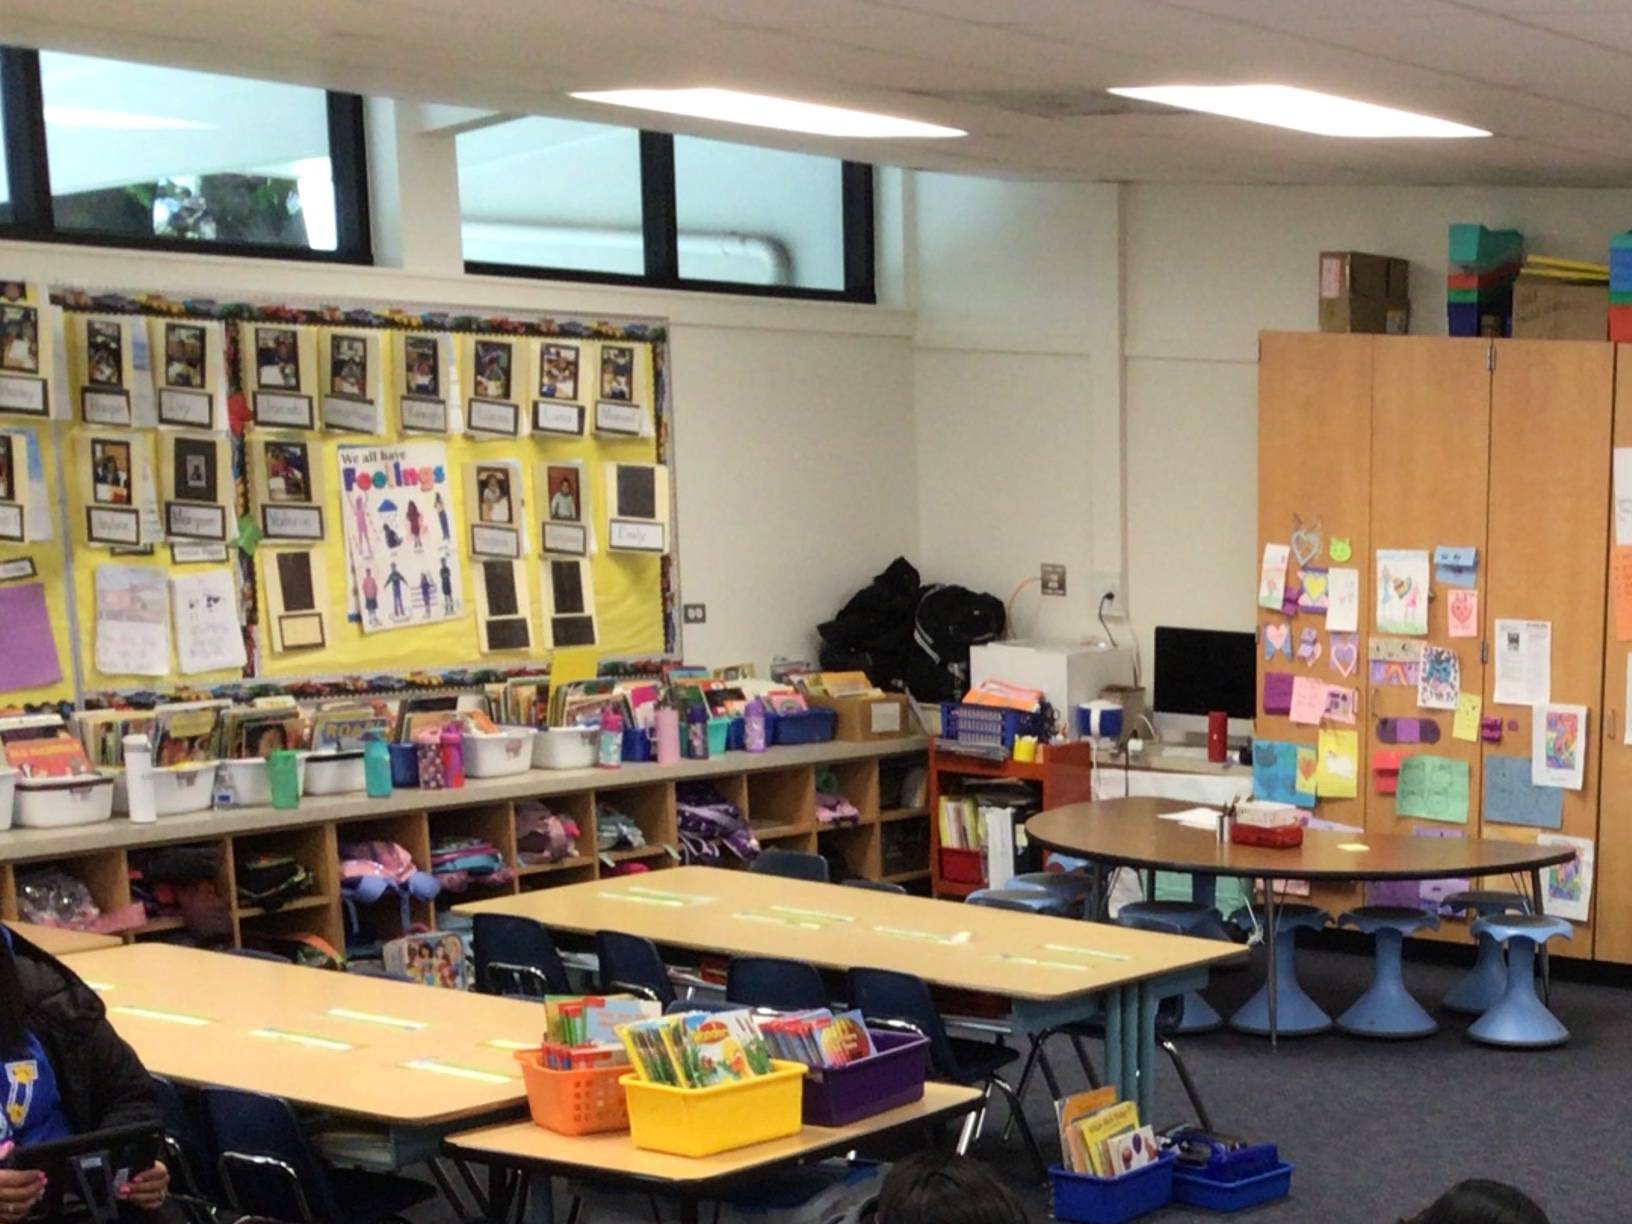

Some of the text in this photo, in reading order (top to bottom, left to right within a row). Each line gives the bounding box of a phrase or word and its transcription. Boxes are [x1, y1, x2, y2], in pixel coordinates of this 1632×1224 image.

[341, 450, 406, 464] We all have
[343, 461, 445, 492] Feelings
